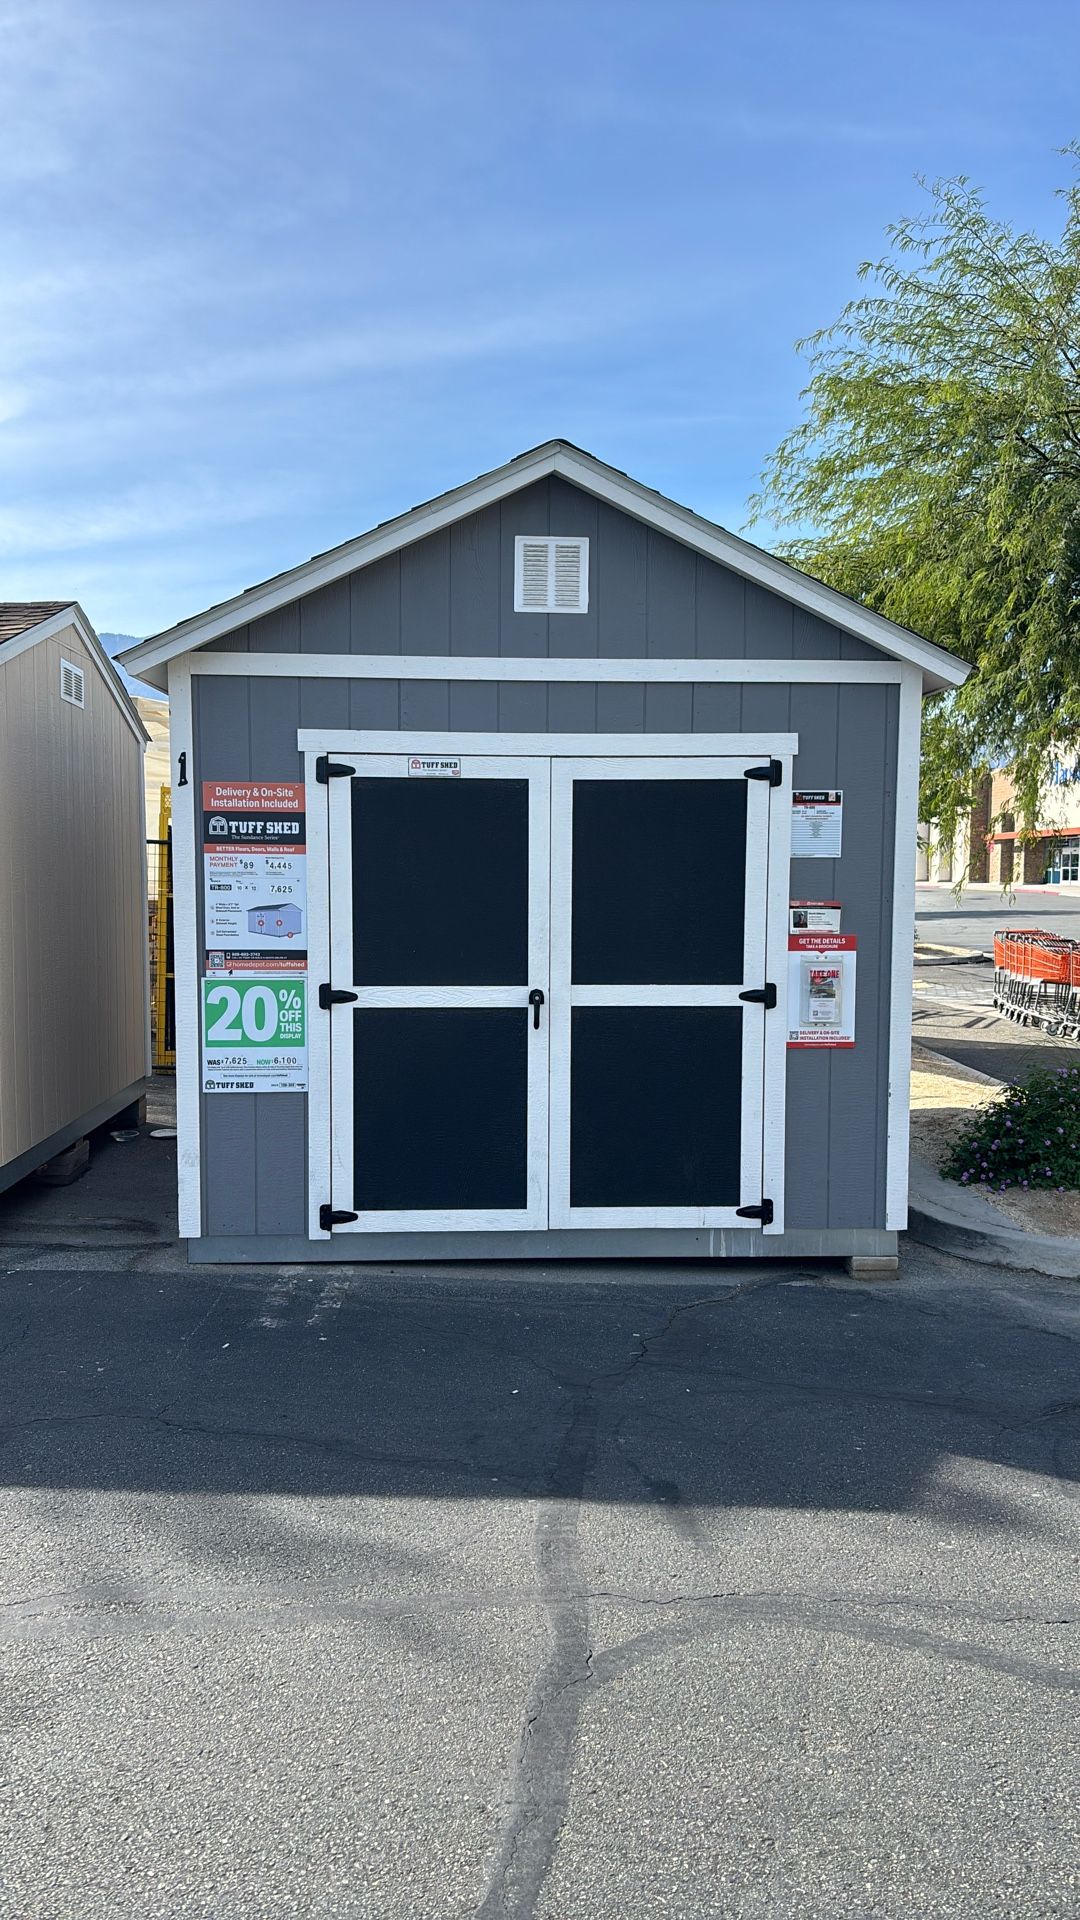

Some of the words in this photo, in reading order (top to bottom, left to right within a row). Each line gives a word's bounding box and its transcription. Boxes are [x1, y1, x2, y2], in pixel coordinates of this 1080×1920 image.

[178, 752, 188, 787] 1
[216, 787, 250, 798] Delivery
[253, 788, 259, 796] &
[261, 788, 294, 797] On-Site
[211, 799, 260, 808] Installation
[262, 800, 298, 808] Included
[229, 822, 264, 834] TUFF
[266, 822, 300, 834] SHED
[232, 961, 304, 970] homedepot.com/tuffshed
[810, 970, 826, 978] TAKE
[827, 970, 840, 978] ONE
[280, 1010, 302, 1022] OFF
[280, 1023, 302, 1032] THIS
